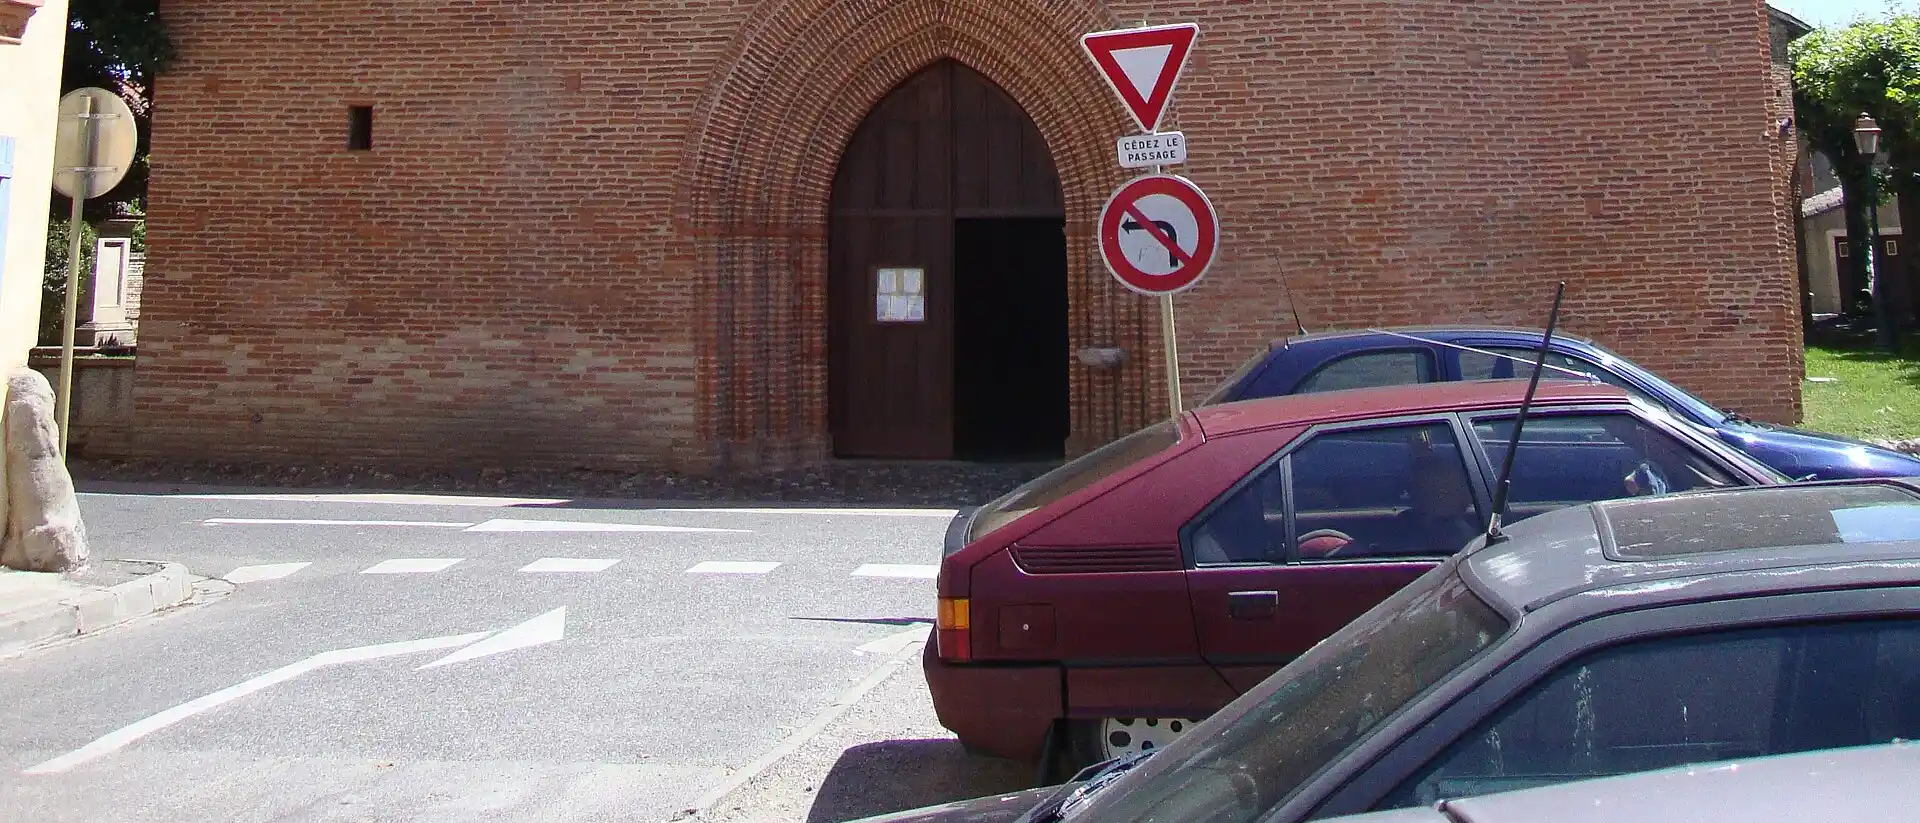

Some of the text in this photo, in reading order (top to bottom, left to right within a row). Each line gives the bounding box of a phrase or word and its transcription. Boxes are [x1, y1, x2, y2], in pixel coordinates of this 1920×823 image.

[1124, 137, 1179, 151] CÉDEZ LE
[1128, 149, 1177, 162] PASSAGE
